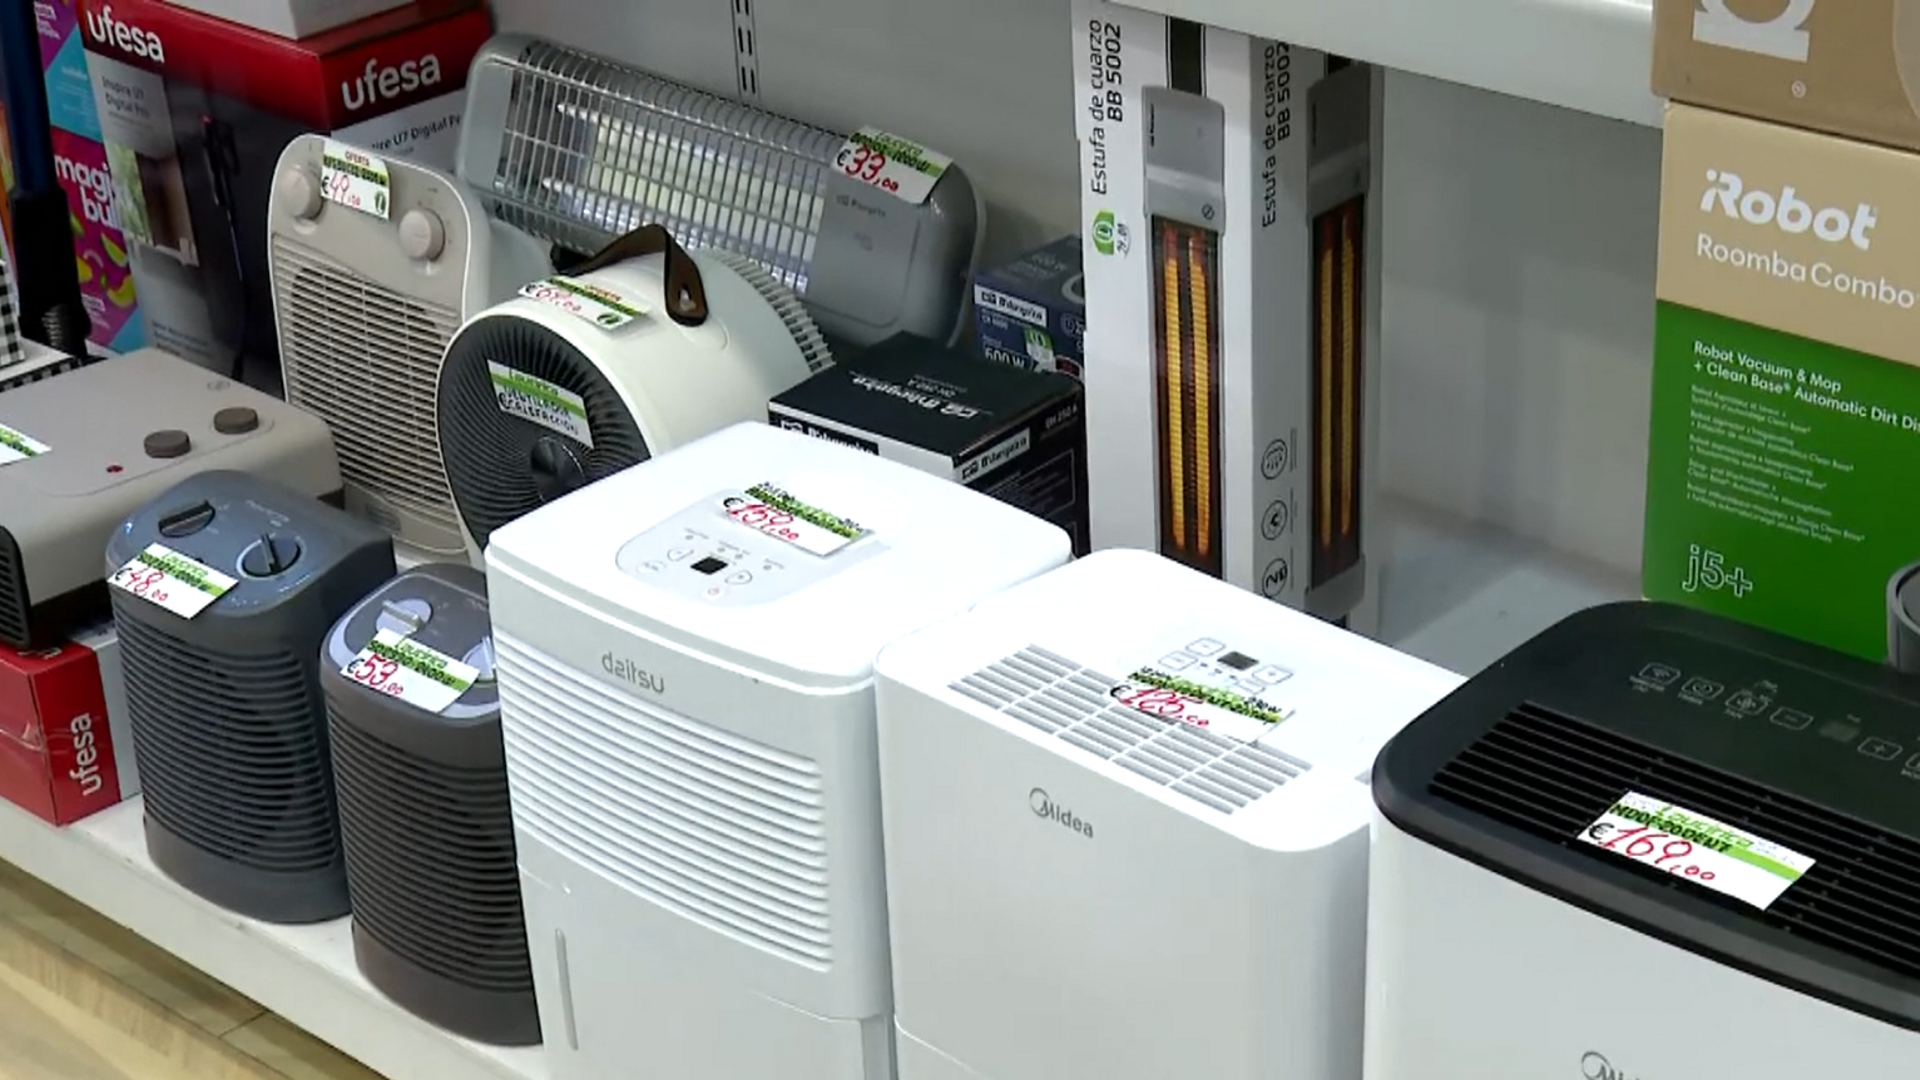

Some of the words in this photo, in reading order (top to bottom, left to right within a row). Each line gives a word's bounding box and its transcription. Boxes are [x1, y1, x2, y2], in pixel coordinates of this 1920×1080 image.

[87, 4, 165, 63] ufesa
[1089, 19, 1103, 90] cuarzo
[1104, 22, 1122, 85] 5002
[341, 53, 442, 110] ufesa
[1088, 94, 1104, 122] de
[1107, 89, 1123, 123] BB
[1264, 45, 1277, 119] cuarzo
[1262, 123, 1277, 150] de
[1277, 108, 1291, 142] BB
[1089, 126, 1107, 195] Estufa
[1262, 154, 1277, 228] Estufa
[1700, 168, 1878, 251] iRobot
[1696, 232, 1807, 284] Roomba
[1810, 262, 1915, 309] Combo
[1693, 340, 1735, 364] Robot
[1737, 352, 1793, 379] Vacuum
[1796, 368, 1807, 383] &
[1809, 372, 1842, 394] Mop
[1706, 362, 1748, 385] Clean
[1794, 388, 1867, 418] Automatic
[1871, 406, 1898, 427] Dirt
[1682, 543, 1753, 598] j5+
[601, 650, 665, 694] daitsu
[69, 712, 103, 797] ufesa
